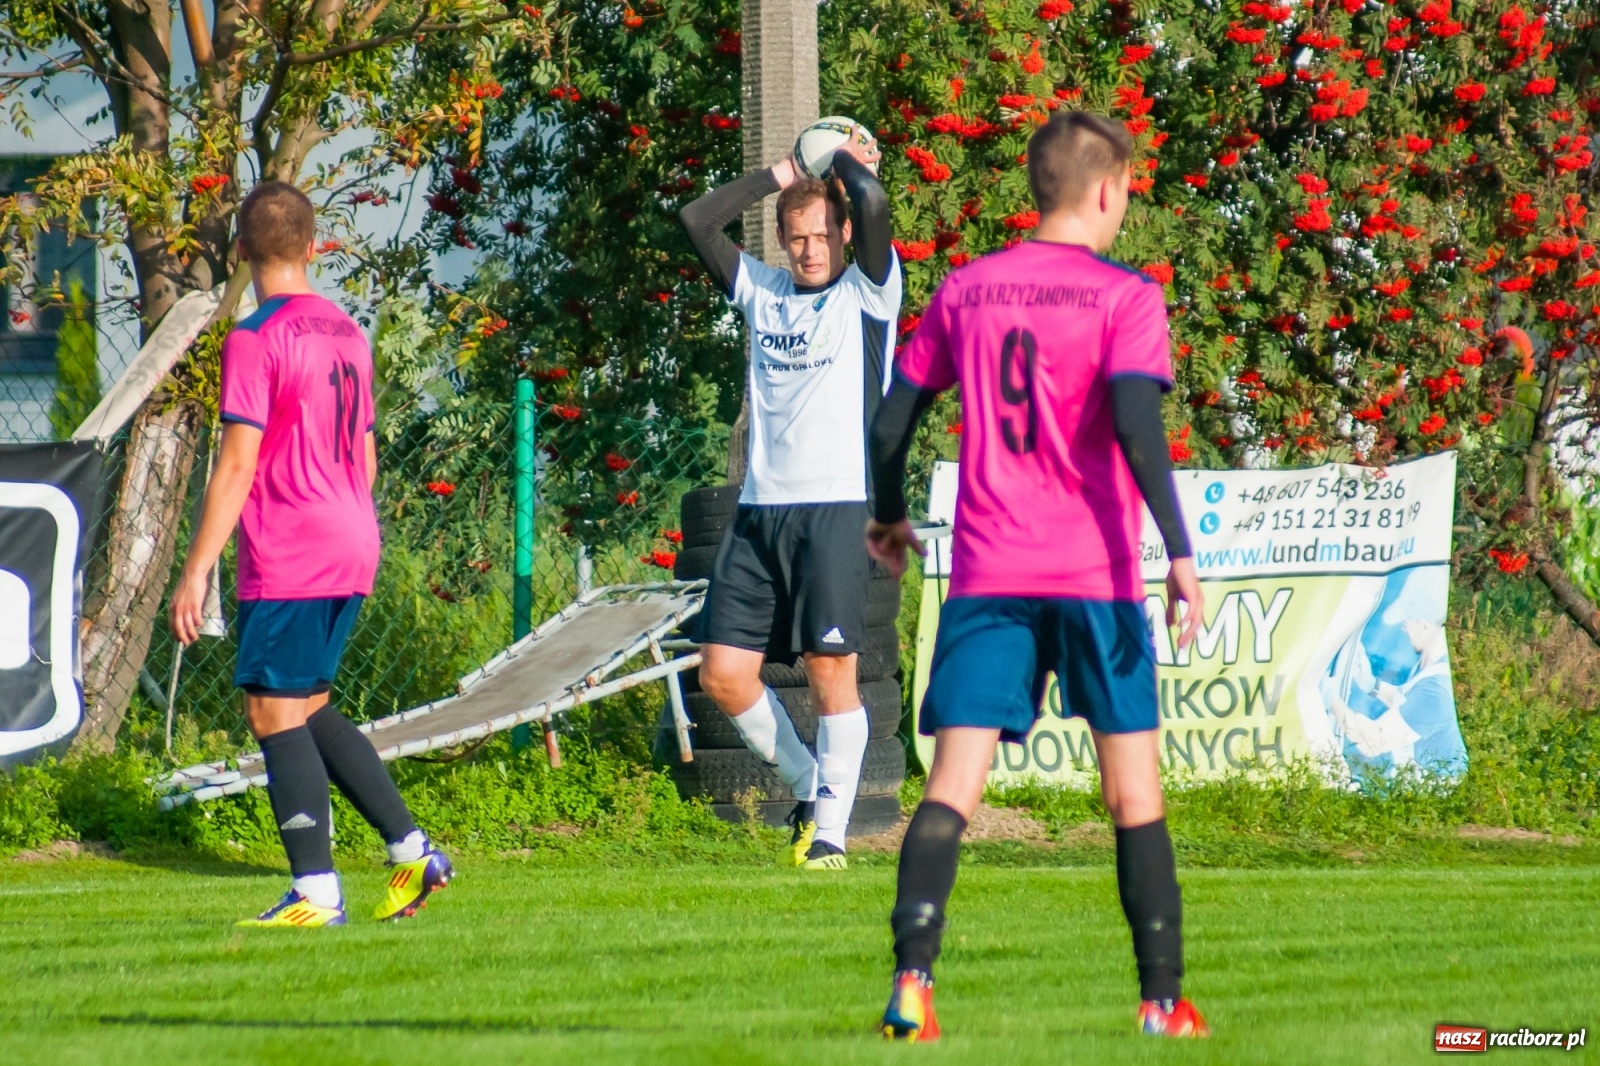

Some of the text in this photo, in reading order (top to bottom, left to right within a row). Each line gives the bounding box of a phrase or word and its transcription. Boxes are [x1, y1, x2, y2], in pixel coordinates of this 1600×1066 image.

[1000, 326, 1038, 455] 9
[1238, 477, 1406, 504] +48 607 543 236
[1233, 510, 1265, 533] +49
[1272, 508, 1305, 530] 151
[1312, 508, 1336, 529] 21
[1343, 508, 1371, 528] 31
[1196, 535, 1415, 569] www.lundmbau.eu
[1145, 587, 1294, 667] AMY
